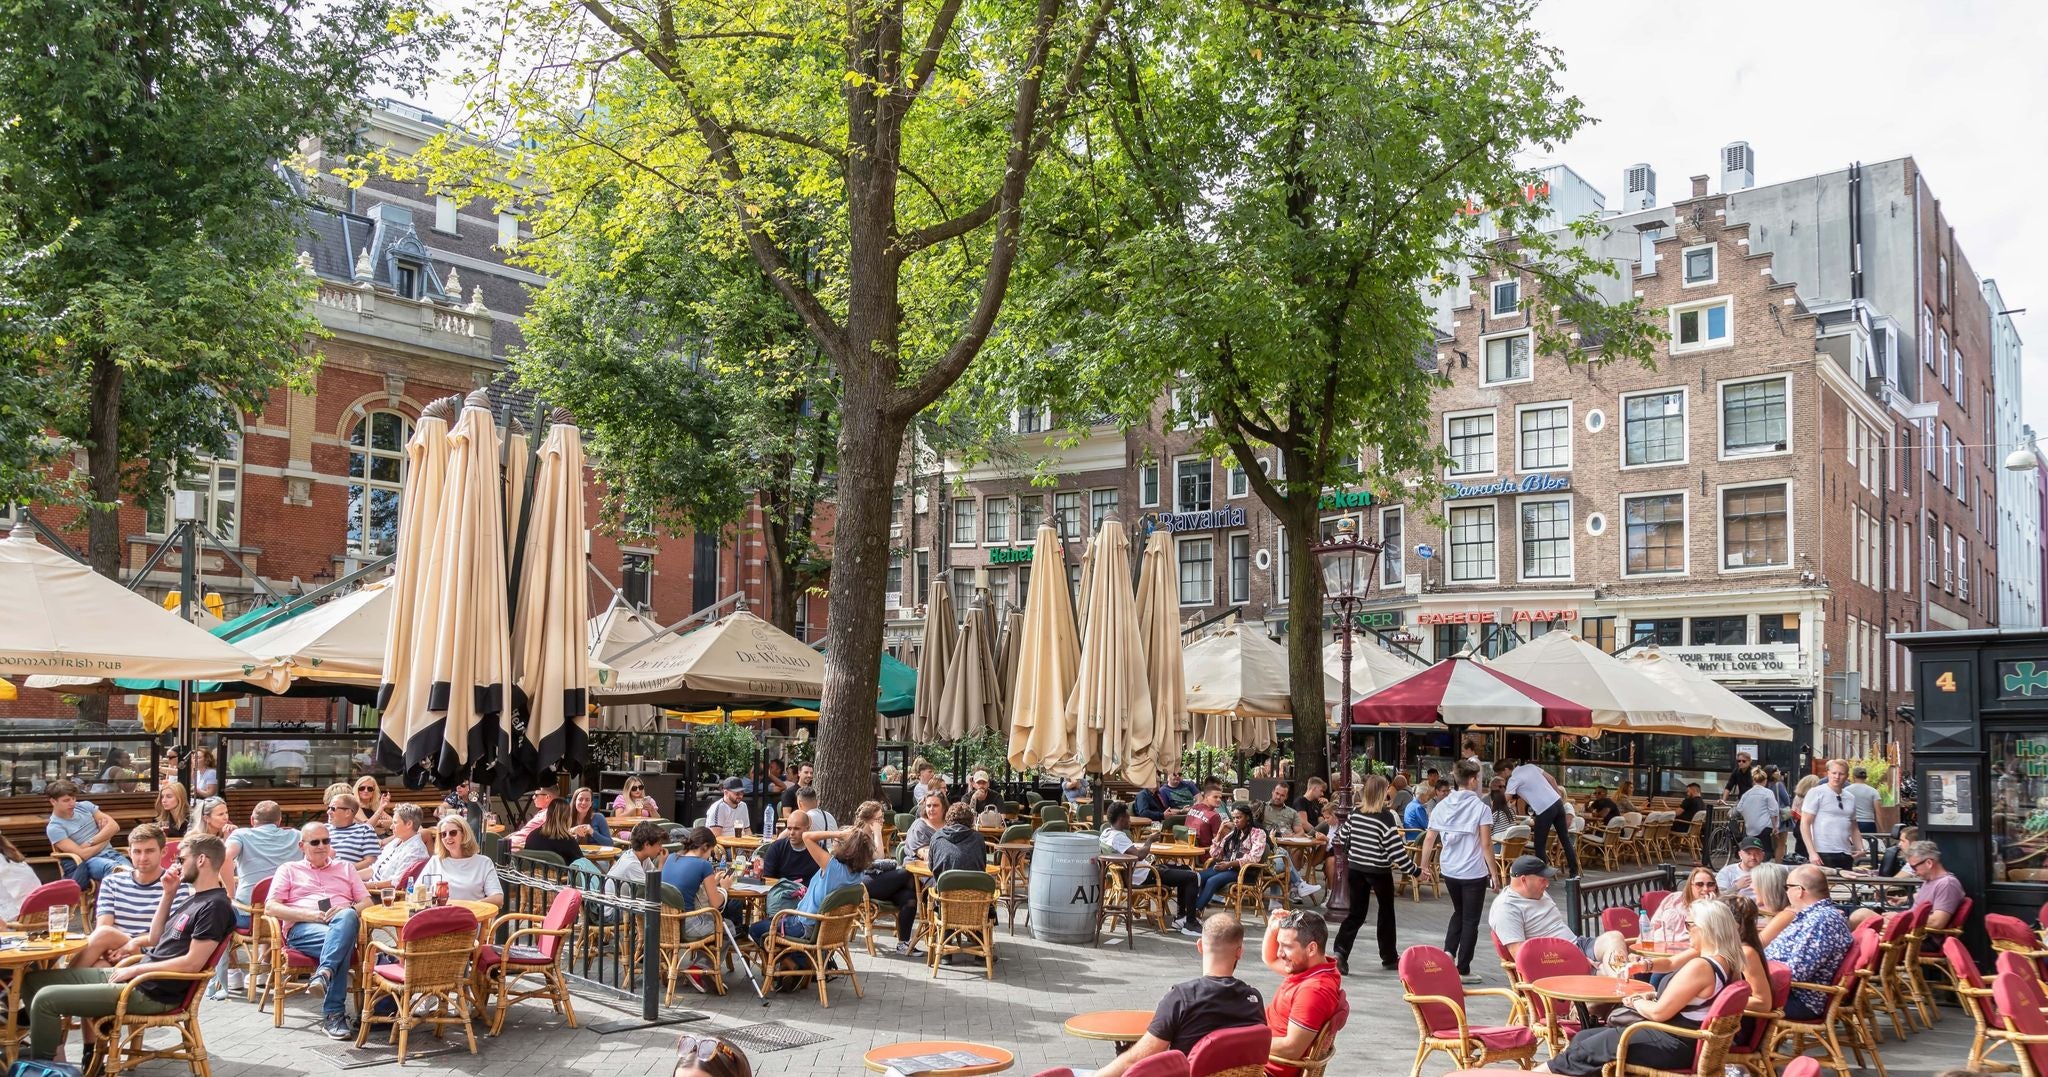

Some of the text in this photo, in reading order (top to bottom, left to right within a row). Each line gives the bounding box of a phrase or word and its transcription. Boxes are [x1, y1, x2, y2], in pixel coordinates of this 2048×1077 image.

[1159, 504, 1245, 532] Bavaria
[1512, 609, 1577, 622] AARD
[1678, 652, 1775, 662] YOUR TRUE COLORS
[97, 660, 122, 669] PUB
[1697, 662, 1718, 671] WHY
[1731, 662, 1757, 671] LOVE
[1763, 661, 1783, 670] YOU
[1936, 672, 1956, 692] 4
